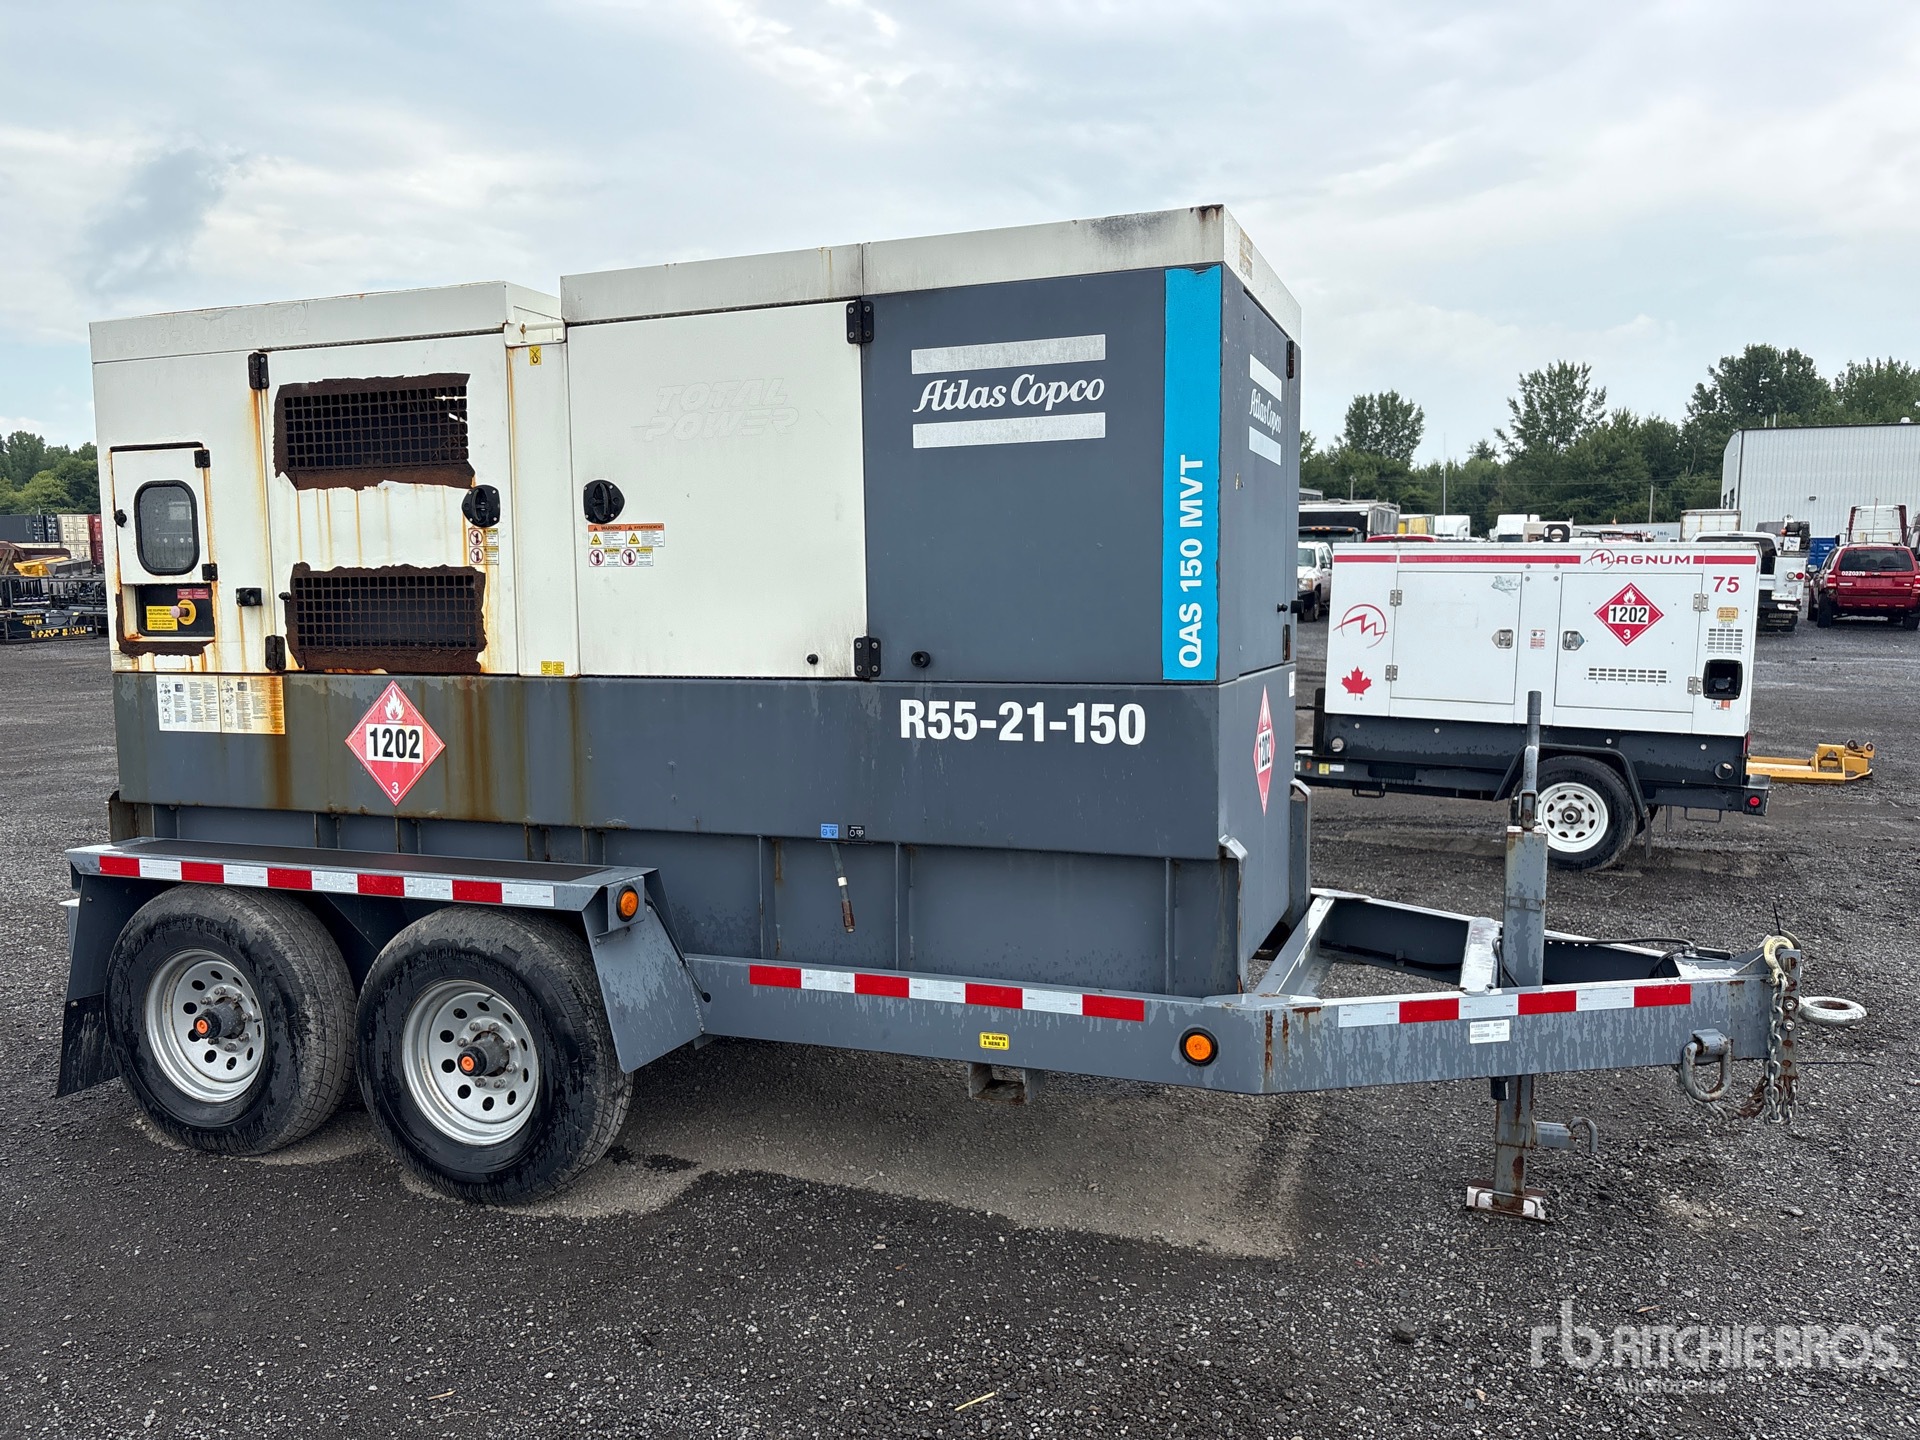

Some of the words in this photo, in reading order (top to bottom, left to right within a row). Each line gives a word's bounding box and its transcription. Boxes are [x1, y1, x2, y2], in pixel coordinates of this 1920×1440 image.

[656, 378, 788, 413] TOTAL
[913, 379, 1007, 412] Atlas
[1010, 373, 1105, 411] Copco
[1249, 388, 1267, 424] Atlas
[1266, 399, 1282, 436] Copco
[1179, 454, 1203, 528] MVT
[1179, 538, 1203, 592] 150
[1713, 577, 1740, 593] 75
[1610, 606, 1648, 623] 1202
[1179, 603, 1203, 669] QAS
[1623, 629, 1631, 639] 3
[900, 699, 1146, 746] R55-21-150
[370, 727, 420, 759] 1202
[1259, 733, 1270, 769] 1202
[391, 781, 400, 794] 3
